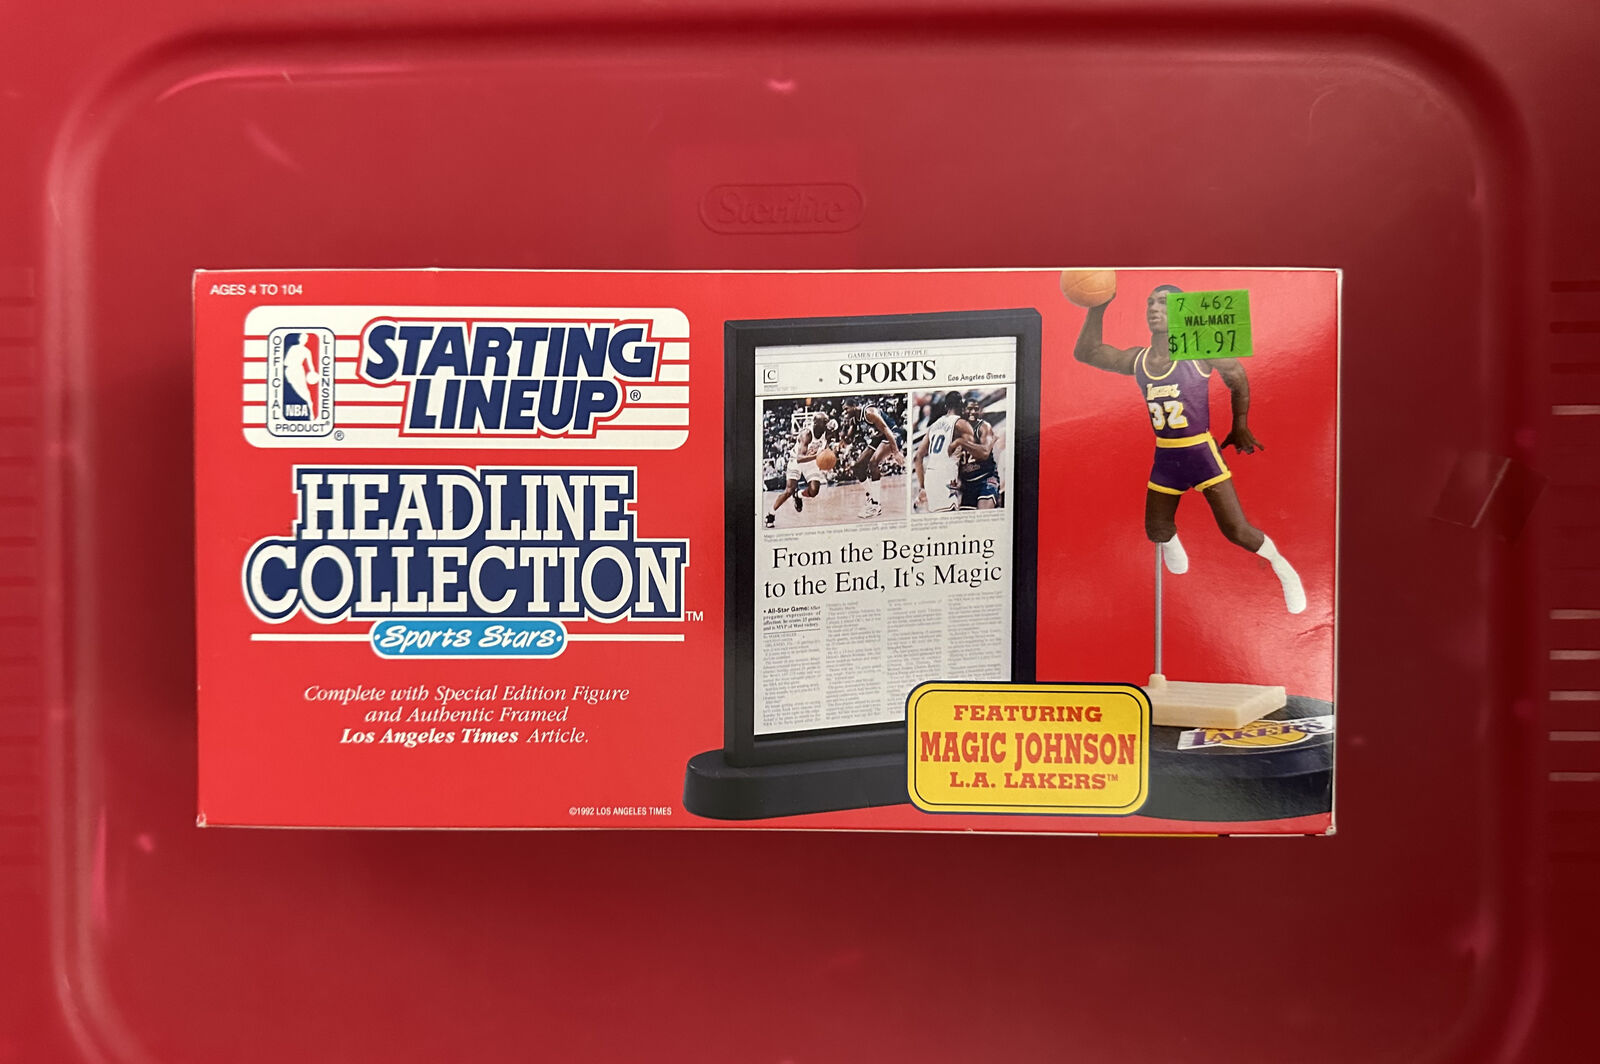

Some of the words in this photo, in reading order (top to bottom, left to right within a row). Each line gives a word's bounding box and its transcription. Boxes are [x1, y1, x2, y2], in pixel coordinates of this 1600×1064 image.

[210, 284, 247, 296] AGES
[249, 284, 258, 296] 4
[260, 284, 279, 296] TO
[281, 284, 303, 296] 104
[1176, 297, 1185, 312] 7
[1200, 295, 1234, 311] 462
[1184, 313, 1236, 327] WAL-MART
[365, 324, 656, 381] STARTING
[1168, 329, 1237, 354] $11.97
[272, 335, 282, 420] OFFICIAL
[321, 334, 331, 420] LICENSED
[767, 369, 776, 381] C
[838, 359, 936, 386] SPORTS
[285, 404, 309, 417] NBA
[409, 378, 619, 431] LINEUP
[1147, 400, 1189, 430] 32
[300, 473, 630, 542] HEADLINE
[772, 547, 832, 569] From
[840, 543, 873, 564] the
[882, 534, 995, 564] Beginning
[250, 545, 682, 614] COLLECTION
[764, 580, 786, 599] to
[794, 575, 827, 596] the
[835, 569, 886, 593] End,
[894, 567, 925, 588] It's
[933, 561, 1002, 588] Magic
[378, 624, 472, 654] Sports
[488, 624, 556, 648] Stars
[303, 685, 386, 705] Complete
[390, 685, 429, 701] with
[434, 685, 498, 705] Special
[502, 685, 567, 701] Edition
[571, 685, 630, 705] Figure
[365, 706, 402, 722] and
[406, 706, 494, 722] Authentic
[498, 706, 569, 722] Framed
[953, 704, 1103, 723] FEATURING
[340, 728, 375, 744] Los
[379, 728, 455, 748] Angeles
[461, 728, 518, 744] Times
[526, 728, 589, 744] Article.
[1191, 720, 1326, 746] LAKERS
[919, 731, 1007, 764] MAGIC
[1014, 732, 1136, 771] JOHNSON
[949, 771, 996, 788] L.A.
[596, 806, 611, 816] LOS
[612, 806, 647, 816] ANGELES
[648, 806, 672, 816] TIMES
